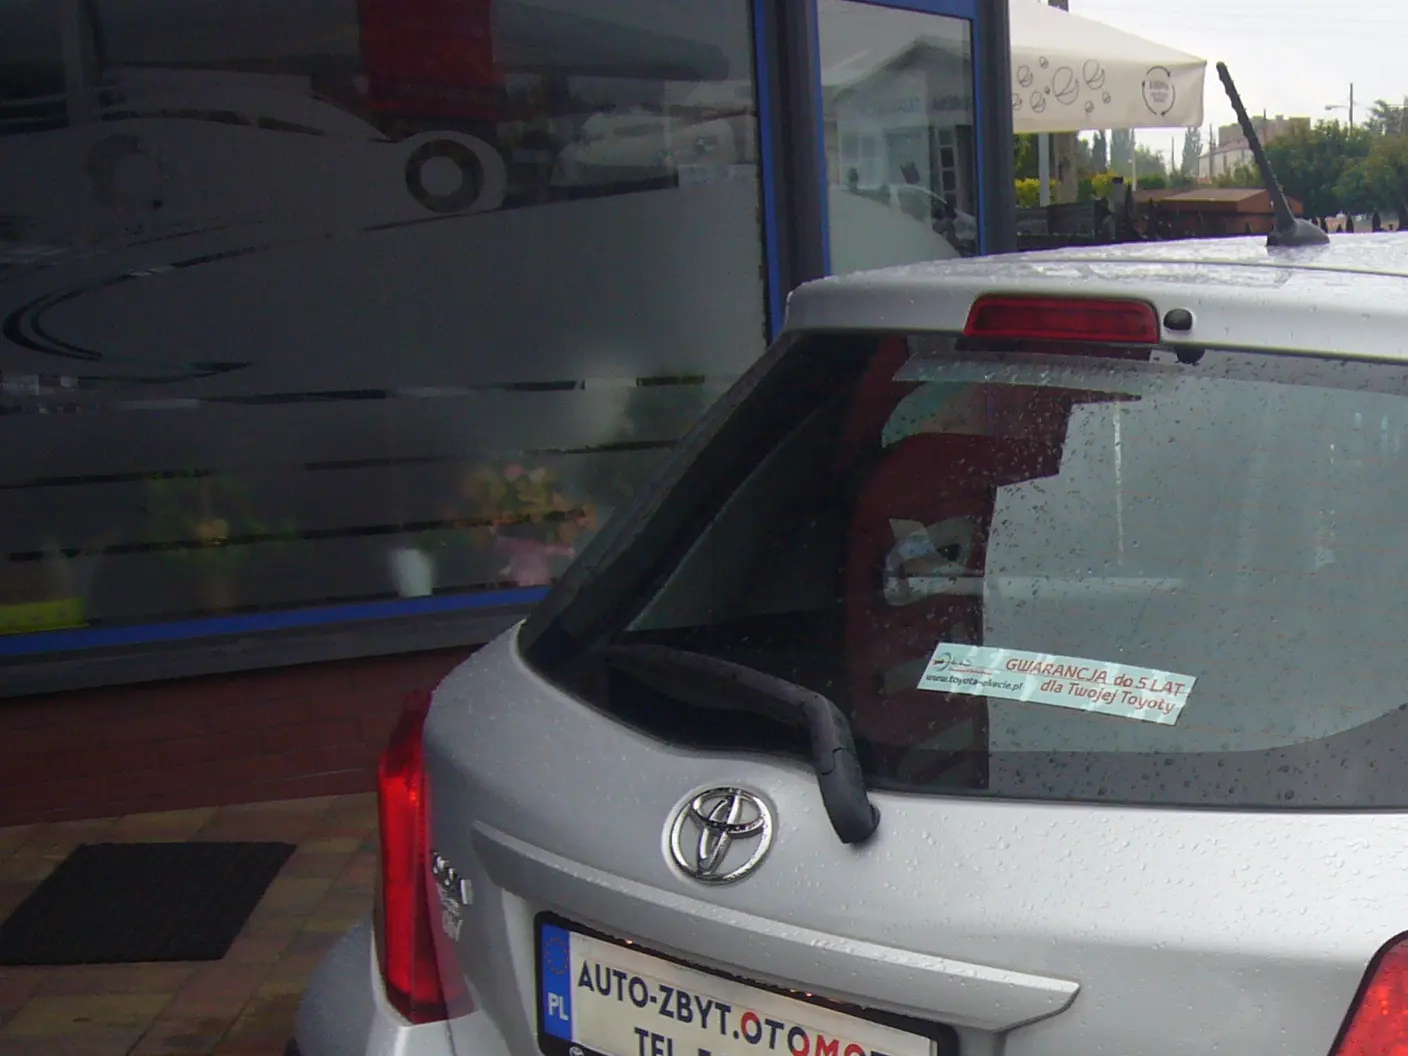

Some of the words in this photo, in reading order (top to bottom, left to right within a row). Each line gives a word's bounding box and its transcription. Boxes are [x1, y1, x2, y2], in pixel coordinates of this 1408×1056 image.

[1006, 658, 1108, 685] GWARANCJA
[1114, 673, 1133, 688] do
[1137, 676, 1149, 690] 5
[1150, 678, 1185, 697] LAT
[1040, 679, 1063, 693] dla
[1067, 682, 1118, 705] Twojej
[1120, 690, 1176, 715] Toyoty
[548, 991, 569, 1021] PL
